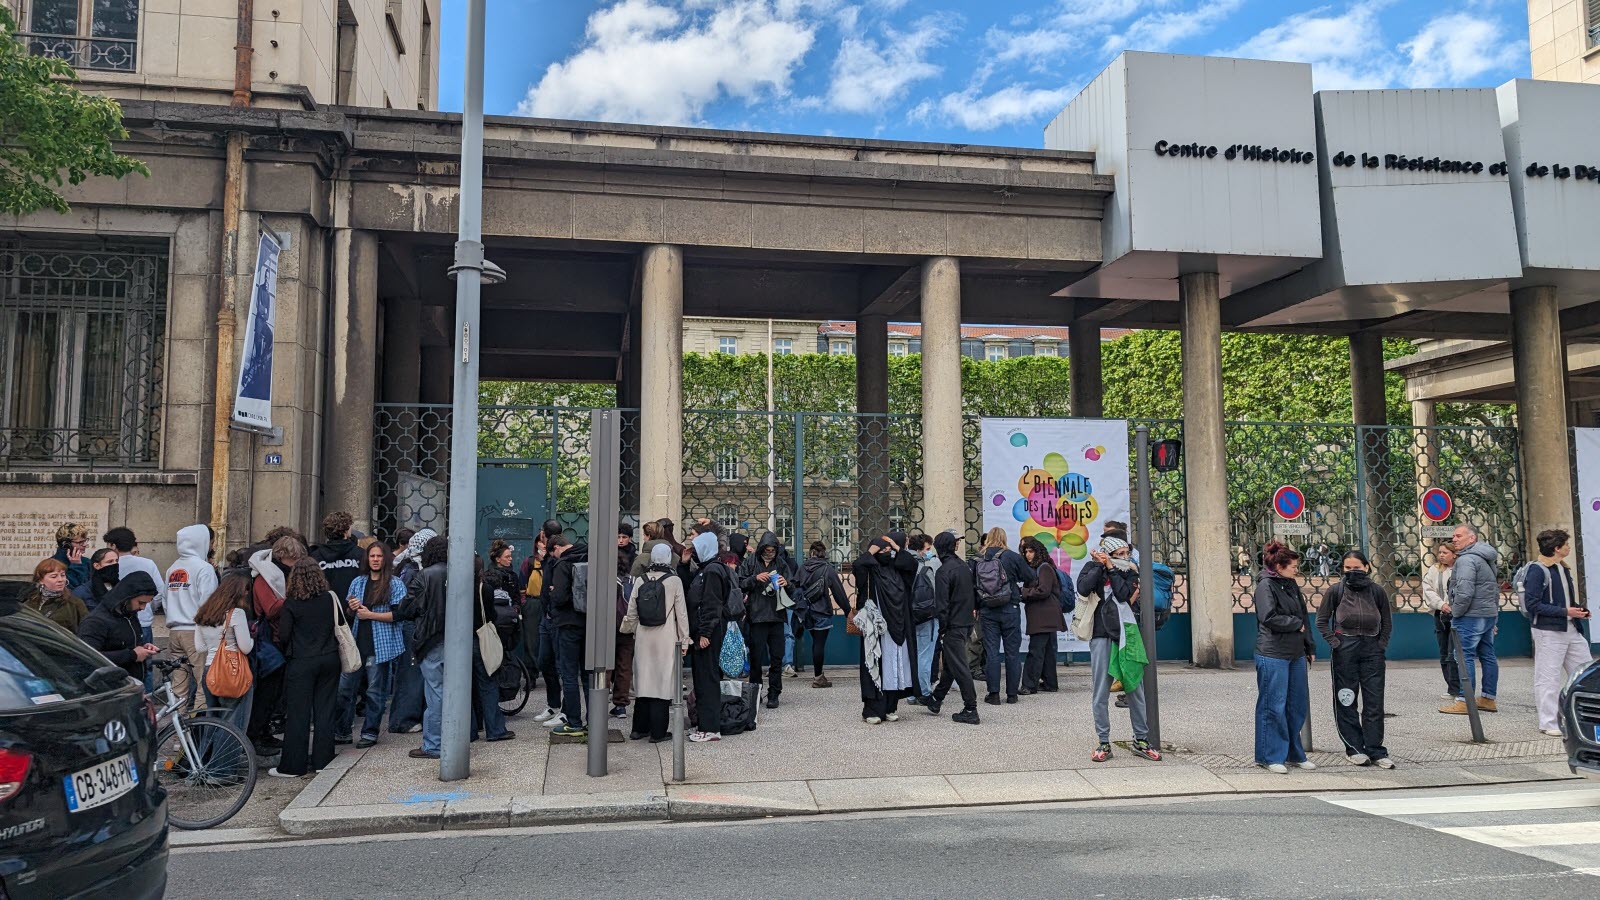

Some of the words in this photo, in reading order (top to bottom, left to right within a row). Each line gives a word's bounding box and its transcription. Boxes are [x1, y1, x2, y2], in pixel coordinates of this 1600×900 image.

[1155, 140, 1218, 158] Centre
[1225, 144, 1314, 164] d'Histoire
[1333, 151, 1355, 168] de
[1362, 152, 1379, 169] la
[1385, 154, 1483, 174] Résistance
[1489, 161, 1508, 176] et
[1526, 162, 1549, 177] de
[1553, 164, 1570, 179] la
[1575, 164, 1600, 184] Dé
[1034, 475, 1089, 498] BIENNALE
[1024, 500, 1038, 511] DES
[1041, 500, 1092, 526] LANGUES
[76, 758, 132, 802] CB-348-PN
